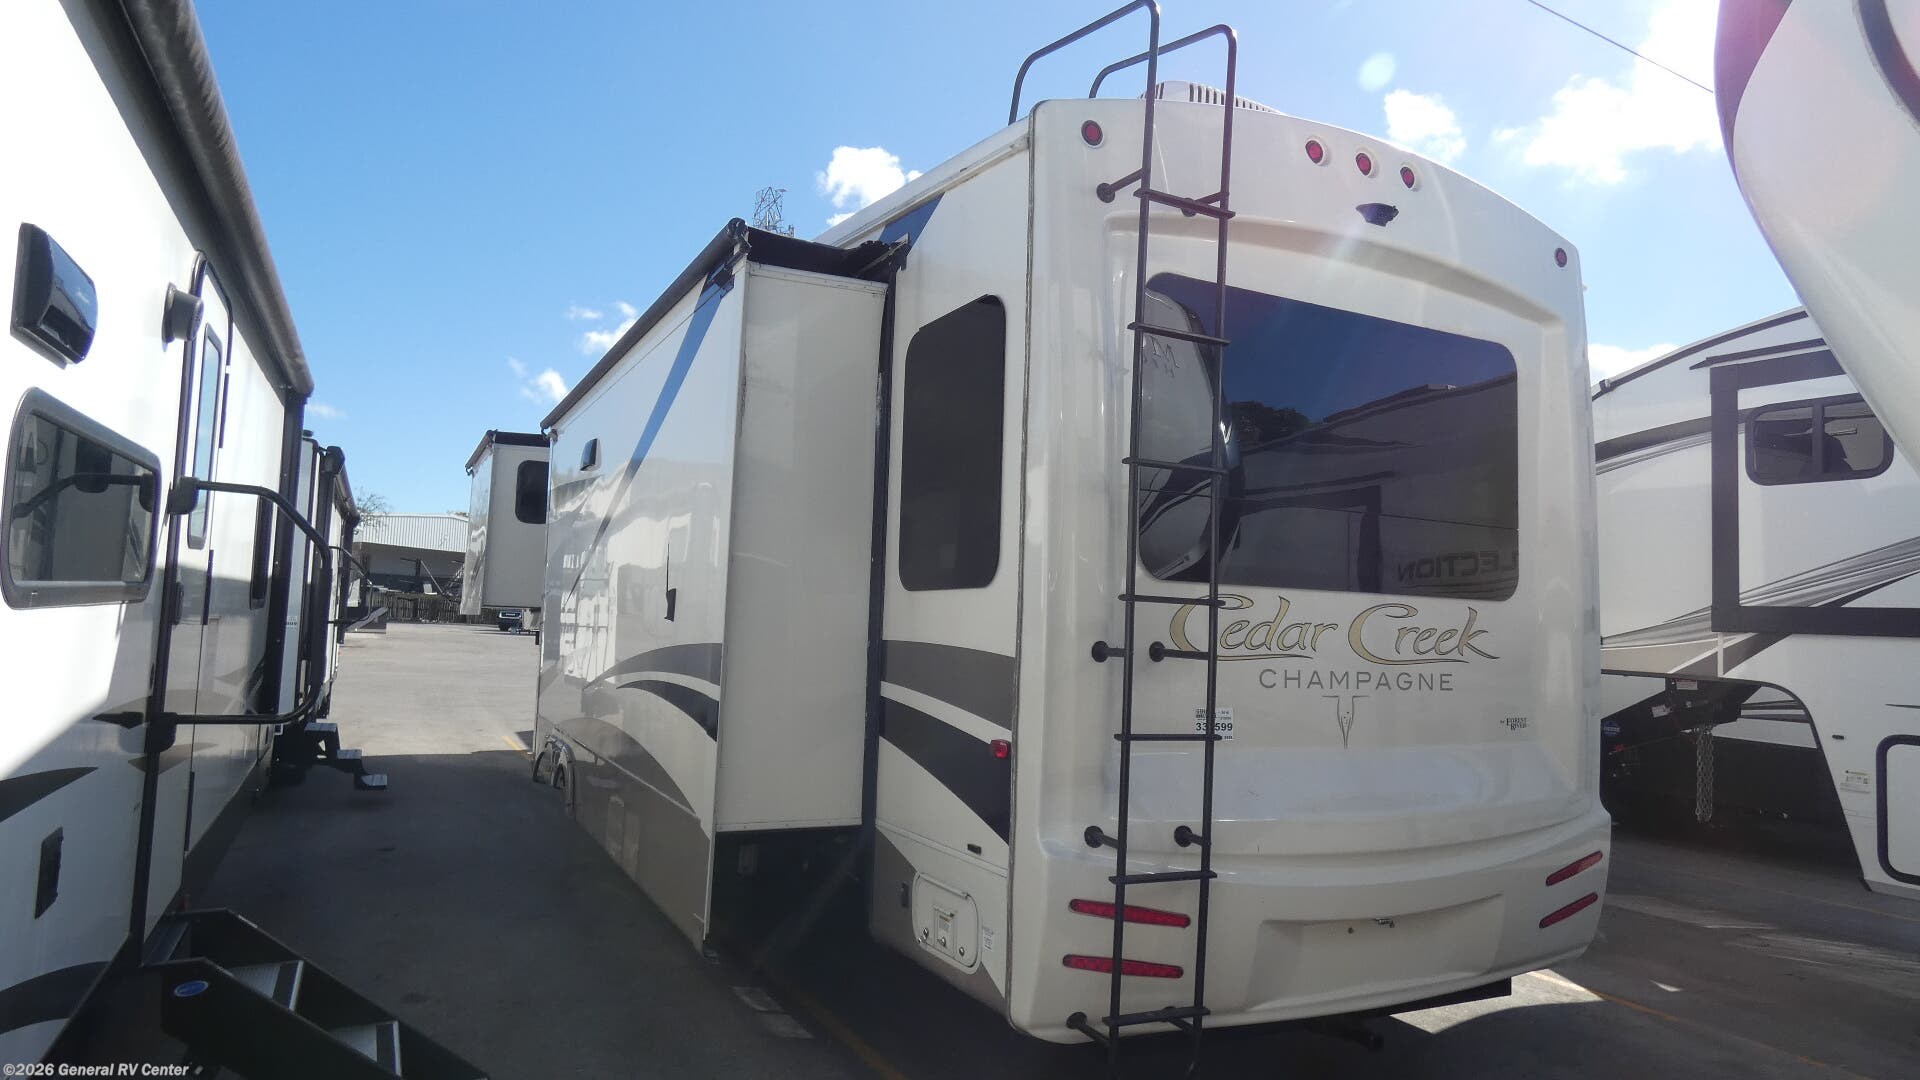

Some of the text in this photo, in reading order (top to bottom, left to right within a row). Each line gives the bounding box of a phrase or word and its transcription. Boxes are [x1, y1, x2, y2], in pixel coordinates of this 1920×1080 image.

[1169, 593, 1501, 665] Cedar Creek
[1259, 668, 1454, 692] CHAMPAGNE
[1195, 722, 1233, 732] 33599
